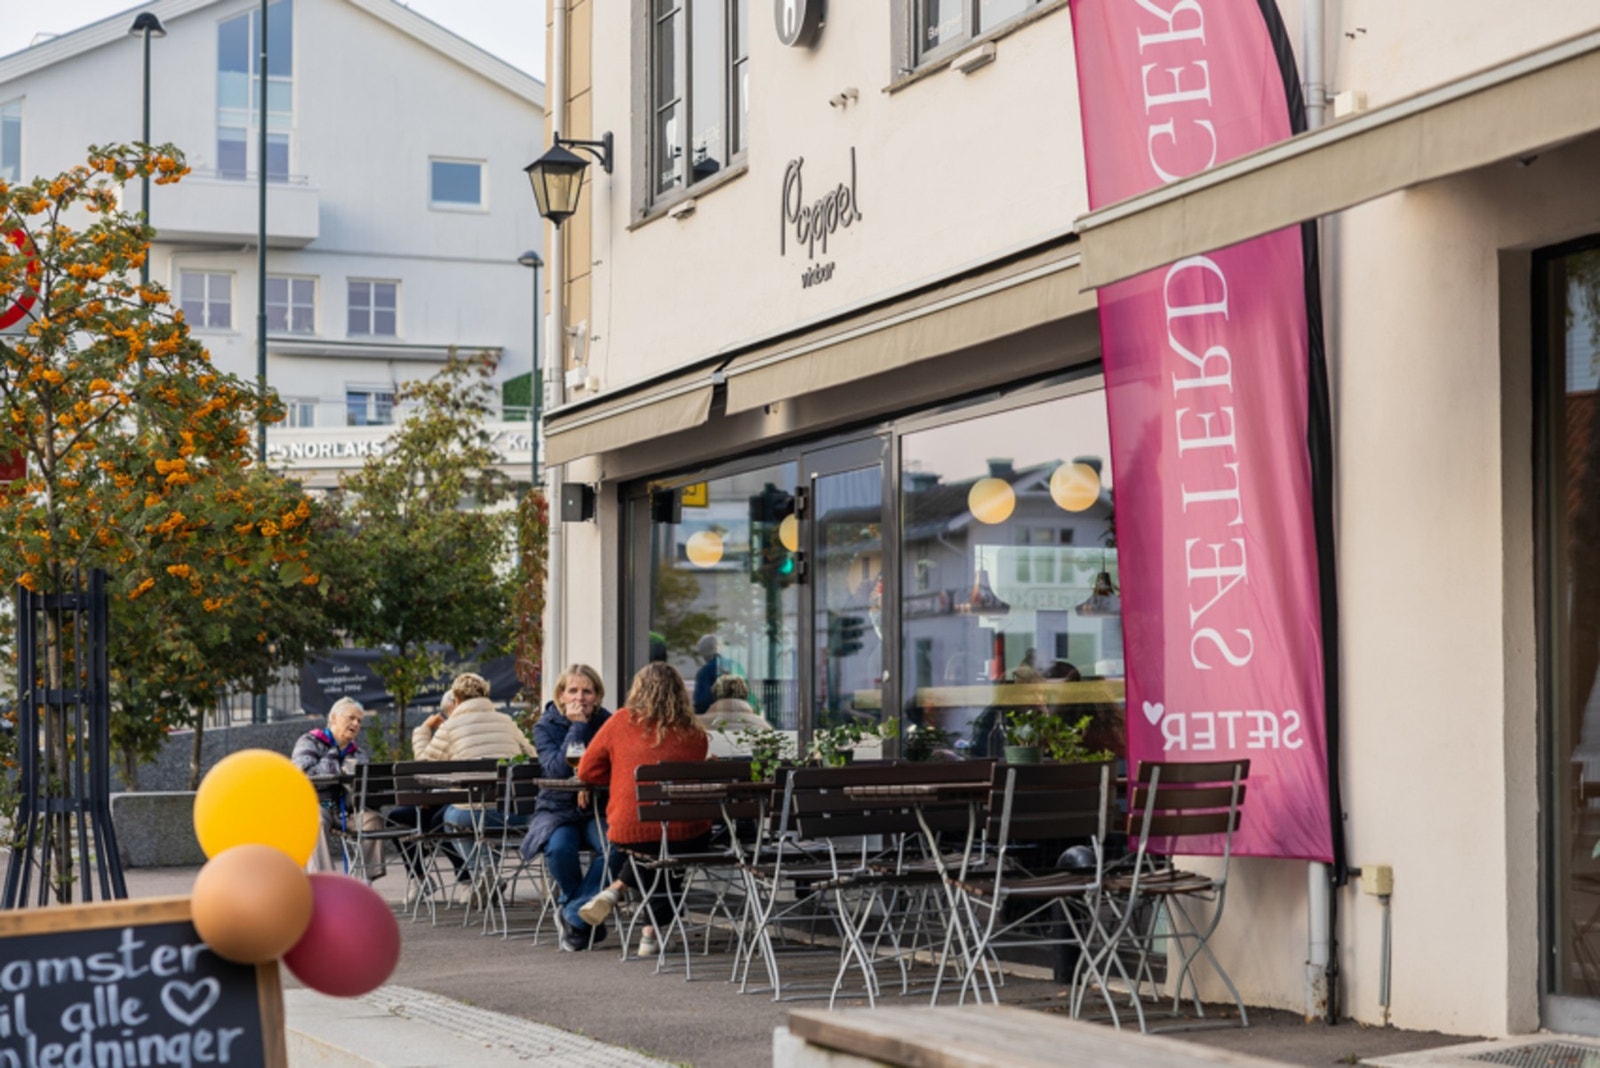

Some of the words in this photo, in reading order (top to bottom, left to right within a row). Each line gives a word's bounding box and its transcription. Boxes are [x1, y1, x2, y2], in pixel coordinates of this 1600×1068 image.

[780, 146, 863, 260] Poppel
[291, 440, 383, 458] NORLAKS
[0, 928, 209, 992] omster
[0, 993, 33, 1038] il
[60, 984, 149, 1033] alle
[0, 1028, 244, 1068] nledninger
